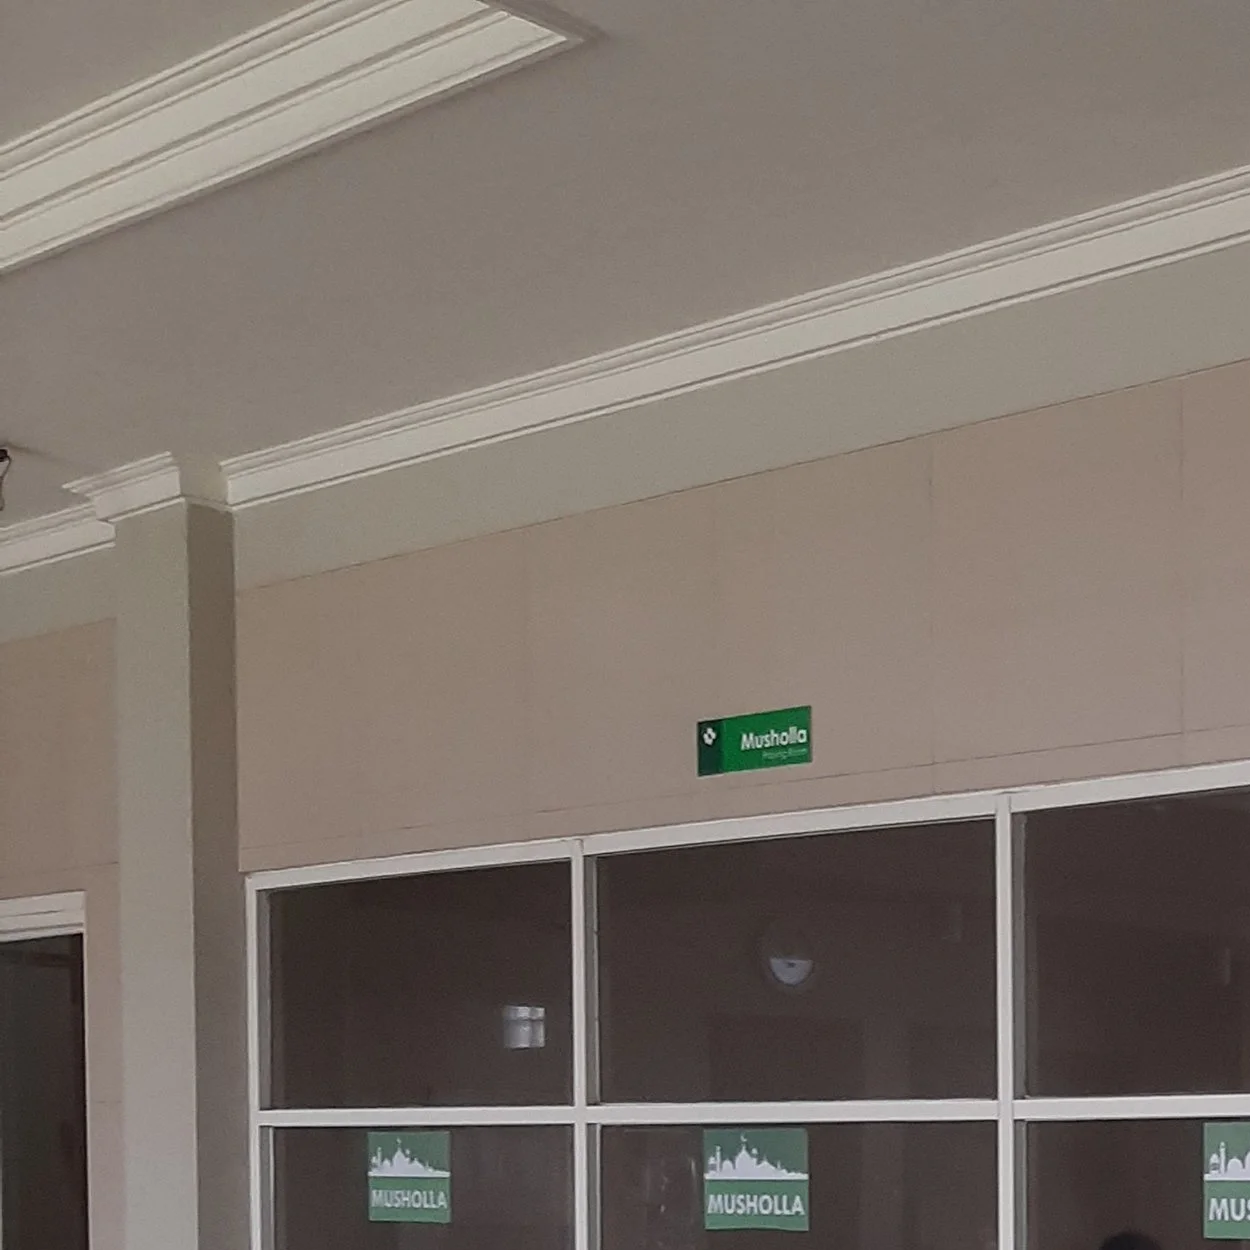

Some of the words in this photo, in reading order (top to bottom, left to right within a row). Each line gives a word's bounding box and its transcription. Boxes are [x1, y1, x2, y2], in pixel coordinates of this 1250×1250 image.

[741, 726, 807, 751] Musholla
[371, 1189, 447, 1208] MUSHOLLA
[708, 1194, 805, 1215] MUSHOLLA
